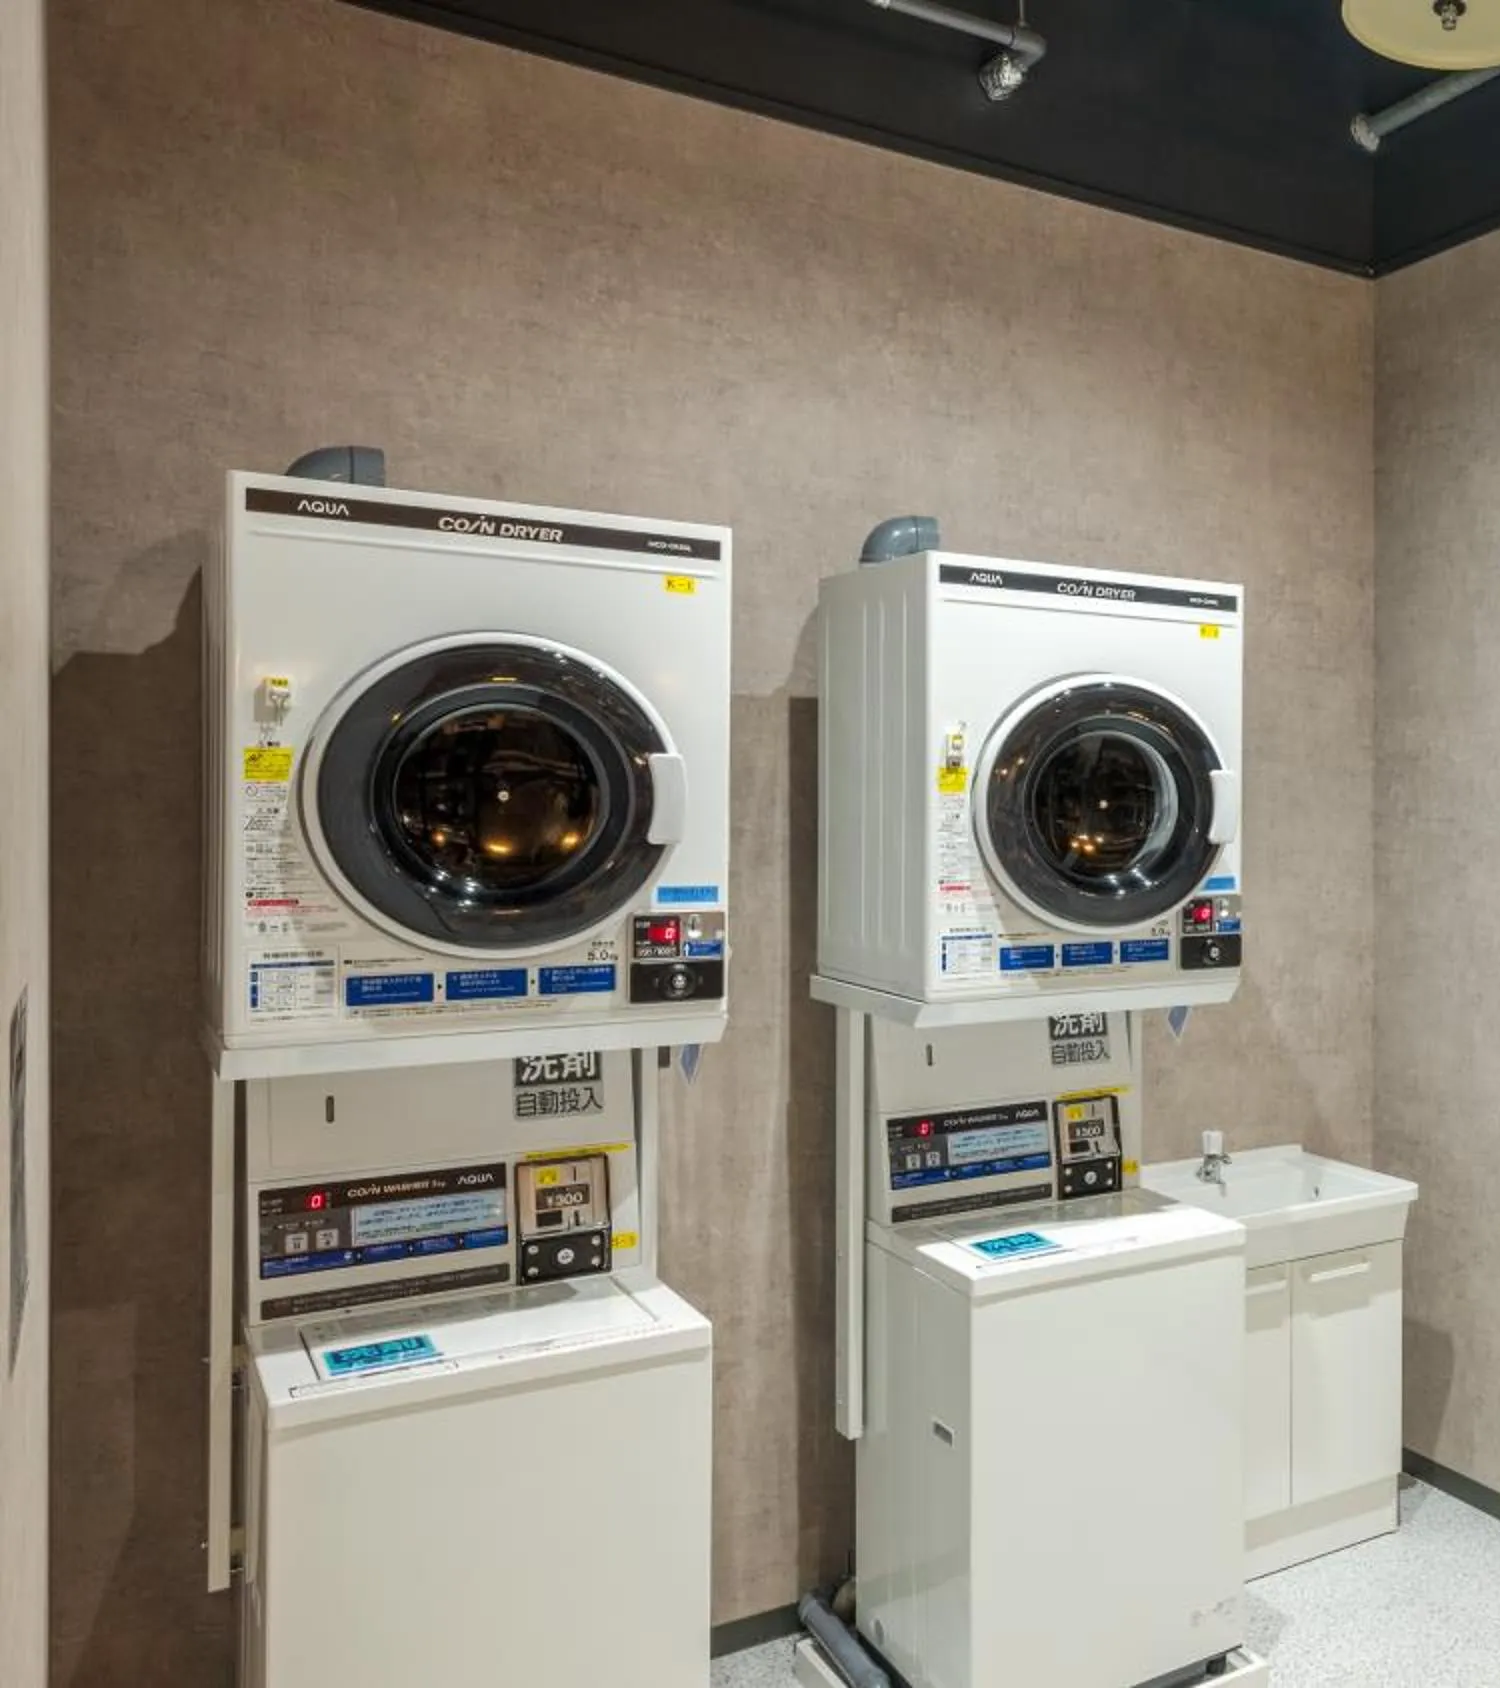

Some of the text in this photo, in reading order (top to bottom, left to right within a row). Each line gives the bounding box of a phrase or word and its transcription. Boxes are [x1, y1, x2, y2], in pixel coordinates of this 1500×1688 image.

[297, 499, 350, 517] AQUA
[499, 520, 564, 544] DRYER
[969, 571, 1003, 586] AQUA
[1095, 586, 1137, 601] DRYER
[1053, 1011, 1105, 1037] 洗剤
[1051, 1039, 1111, 1066] 自動投入
[520, 1049, 598, 1082] 洗剤
[516, 1087, 603, 1118] 自動投入
[456, 1172, 495, 1186] AQUA
